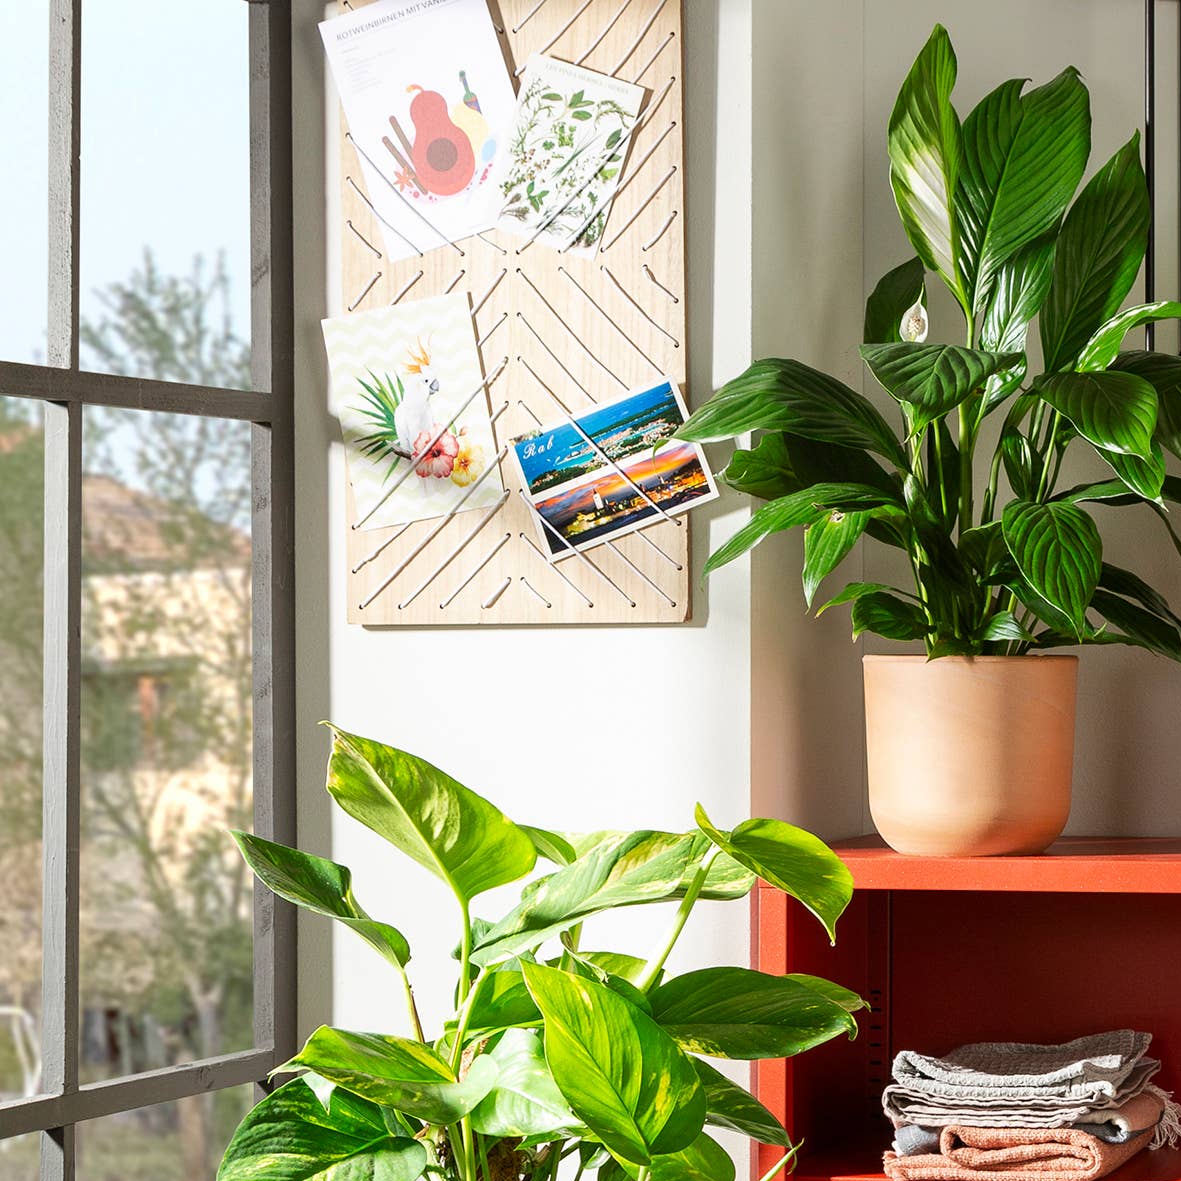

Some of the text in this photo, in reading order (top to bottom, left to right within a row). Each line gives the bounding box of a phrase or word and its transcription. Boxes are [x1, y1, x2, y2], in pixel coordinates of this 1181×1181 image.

[336, 10, 405, 41] ROTWEINBIRNEN
[406, 3, 420, 15] MIT
[523, 434, 554, 459] Rab
